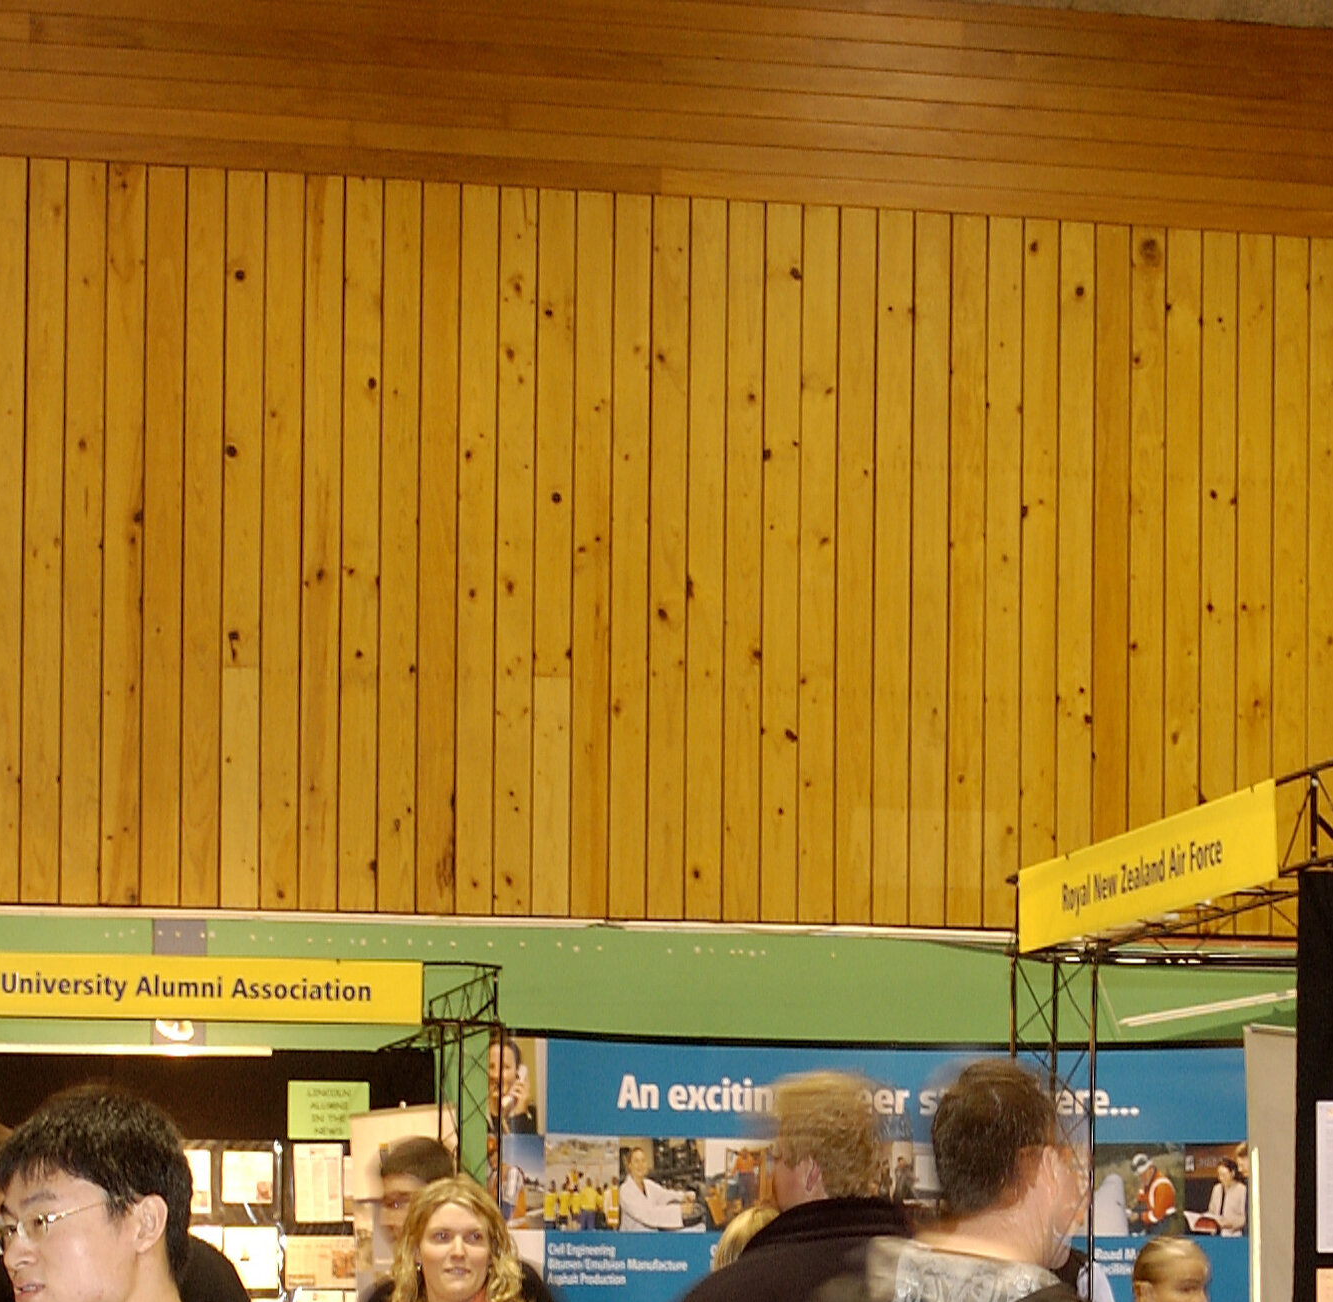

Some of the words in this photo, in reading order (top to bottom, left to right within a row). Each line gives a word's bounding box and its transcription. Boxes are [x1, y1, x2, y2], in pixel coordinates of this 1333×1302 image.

[1061, 873, 1091, 917] Royal
[1094, 873, 1117, 902] New
[1121, 849, 1165, 894] Zealand
[1169, 844, 1186, 879] Air
[1189, 840, 1223, 872] Force
[1, 971, 127, 1002] University
[136, 974, 223, 999] Alumni
[231, 977, 372, 1002] Association
[617, 1073, 660, 1111] An
[668, 1076, 776, 1113] excitin
[1054, 1088, 1141, 1117] ere...
